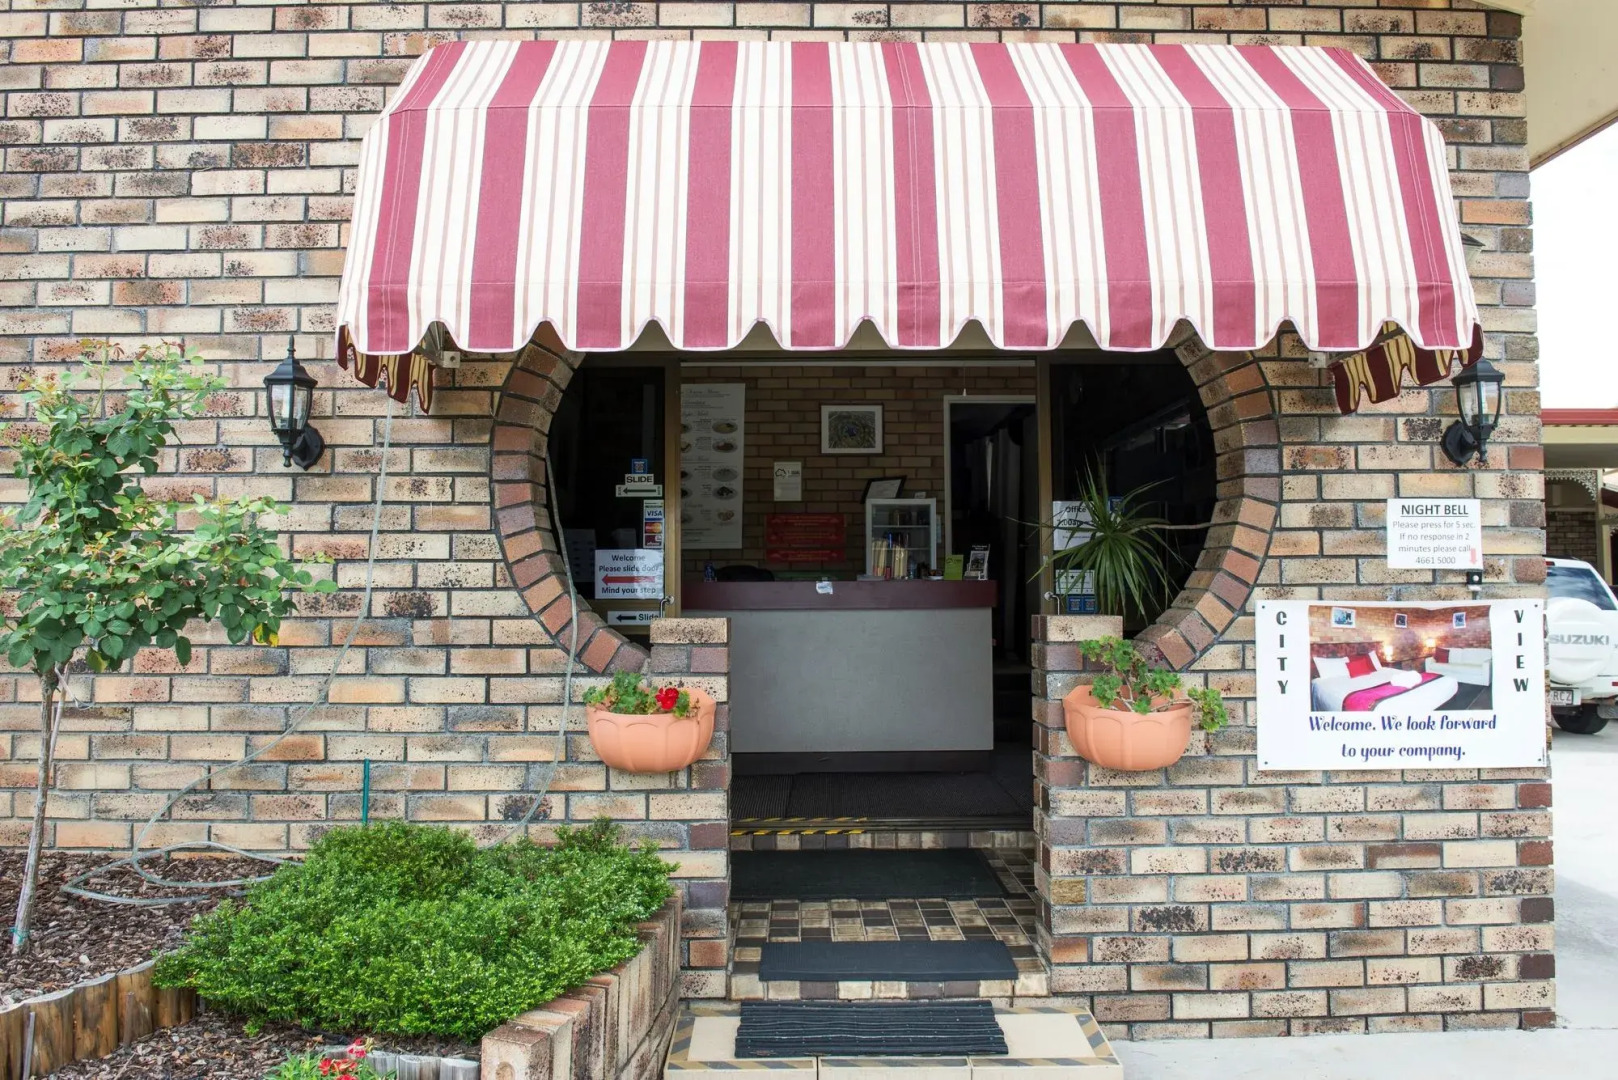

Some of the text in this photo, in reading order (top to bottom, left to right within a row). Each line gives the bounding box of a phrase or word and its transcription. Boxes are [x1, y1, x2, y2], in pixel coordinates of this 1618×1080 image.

[626, 476, 653, 484] SLIDE
[1401, 504, 1468, 515] NIGHT BELL
[1392, 520, 1476, 530] Please press for 5 sec.
[1399, 532, 1406, 540] If
[1420, 534, 1454, 542] response
[1456, 532, 1464, 540] in
[1465, 532, 1470, 540] 2
[1398, 544, 1471, 553] minutes please call
[611, 554, 646, 562] Welcome
[1415, 556, 1456, 564] 4661 5000
[640, 587, 657, 595] step
[638, 613, 659, 621] Slide
[1548, 634, 1610, 645] SUZUKI
[1276, 611, 1289, 695] CITY
[1513, 609, 1529, 693] VIEW
[1553, 691, 1572, 701] RCZ
[1308, 713, 1497, 731] Welcome. We look forward
[1341, 743, 1466, 763] to your company.
